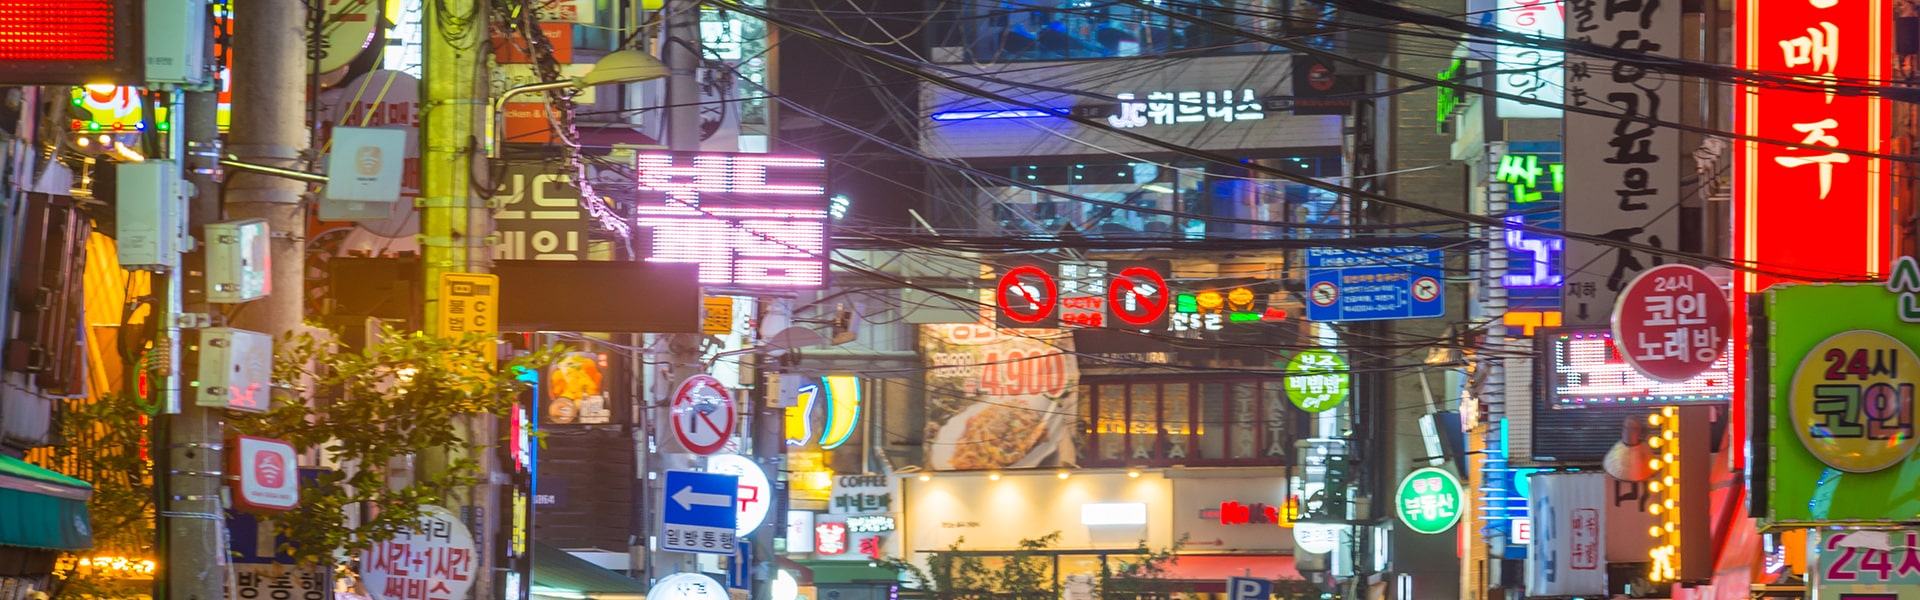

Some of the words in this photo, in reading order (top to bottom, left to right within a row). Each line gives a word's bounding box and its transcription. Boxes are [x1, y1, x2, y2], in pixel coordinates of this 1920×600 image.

[1774, 0, 1851, 200] 맥주
[1496, 154, 1564, 203] 싼
[1568, 281, 1597, 299] 지하
[1654, 274, 1693, 292] 24시
[1062, 297, 1103, 309] CCTV
[1642, 293, 1707, 326] 코인
[1635, 325, 1721, 363] 노래방
[980, 349, 1065, 399] 4,900
[1824, 347, 1898, 381] 24시
[1809, 382, 1915, 441] 코인
[840, 476, 887, 488] COFFEE
[1404, 493, 1454, 521] 부동산
[666, 528, 734, 550] 일방통행
[365, 541, 470, 581] 1시간+1시간
[224, 571, 324, 600] 방통행
[1237, 579, 1262, 600] P
